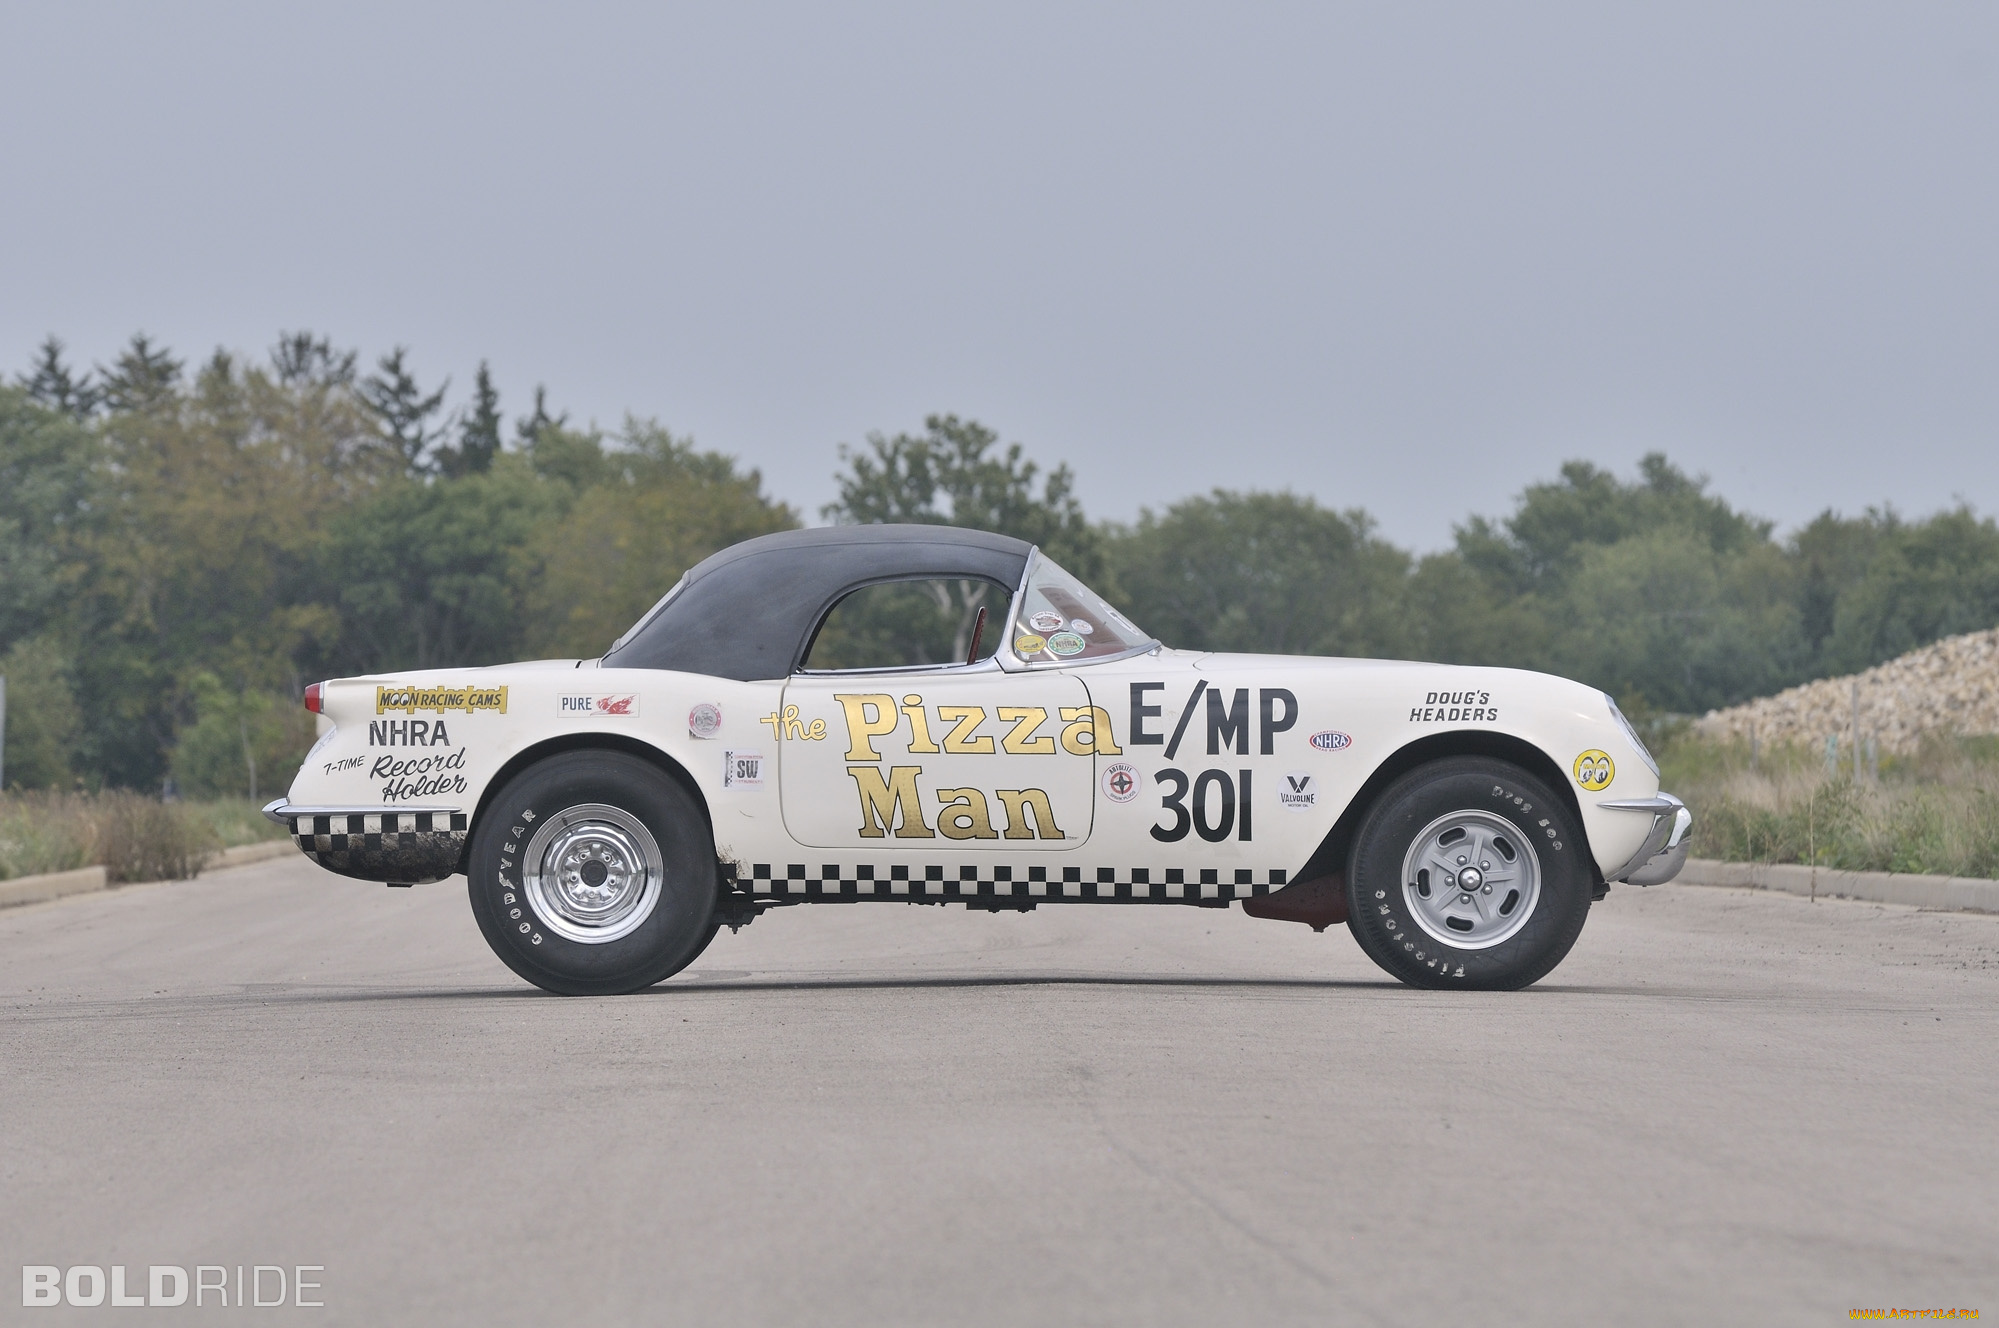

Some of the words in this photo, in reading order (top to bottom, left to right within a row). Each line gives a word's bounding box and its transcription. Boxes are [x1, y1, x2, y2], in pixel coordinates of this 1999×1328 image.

[380, 692, 419, 706] MOON
[420, 693, 464, 706] RACING
[468, 693, 502, 706] CAMS
[562, 697, 592, 711] PURE
[1425, 690, 1490, 705] DOUG'S
[1129, 679, 1299, 761] E/MP
[1409, 708, 1498, 721] HEADERS
[369, 720, 450, 746] NHRA
[759, 704, 827, 741] the
[833, 693, 1123, 762] Pizza
[1316, 734, 1347, 748] NHRA
[323, 755, 365, 775] 7-TIME
[369, 746, 466, 780] Record
[737, 760, 759, 778] SW
[382, 773, 467, 802] Holder
[1280, 792, 1315, 804] VALVOLINE
[846, 765, 1066, 840] Man
[1149, 768, 1253, 843] 301
[498, 808, 542, 945] GOODYEAR
